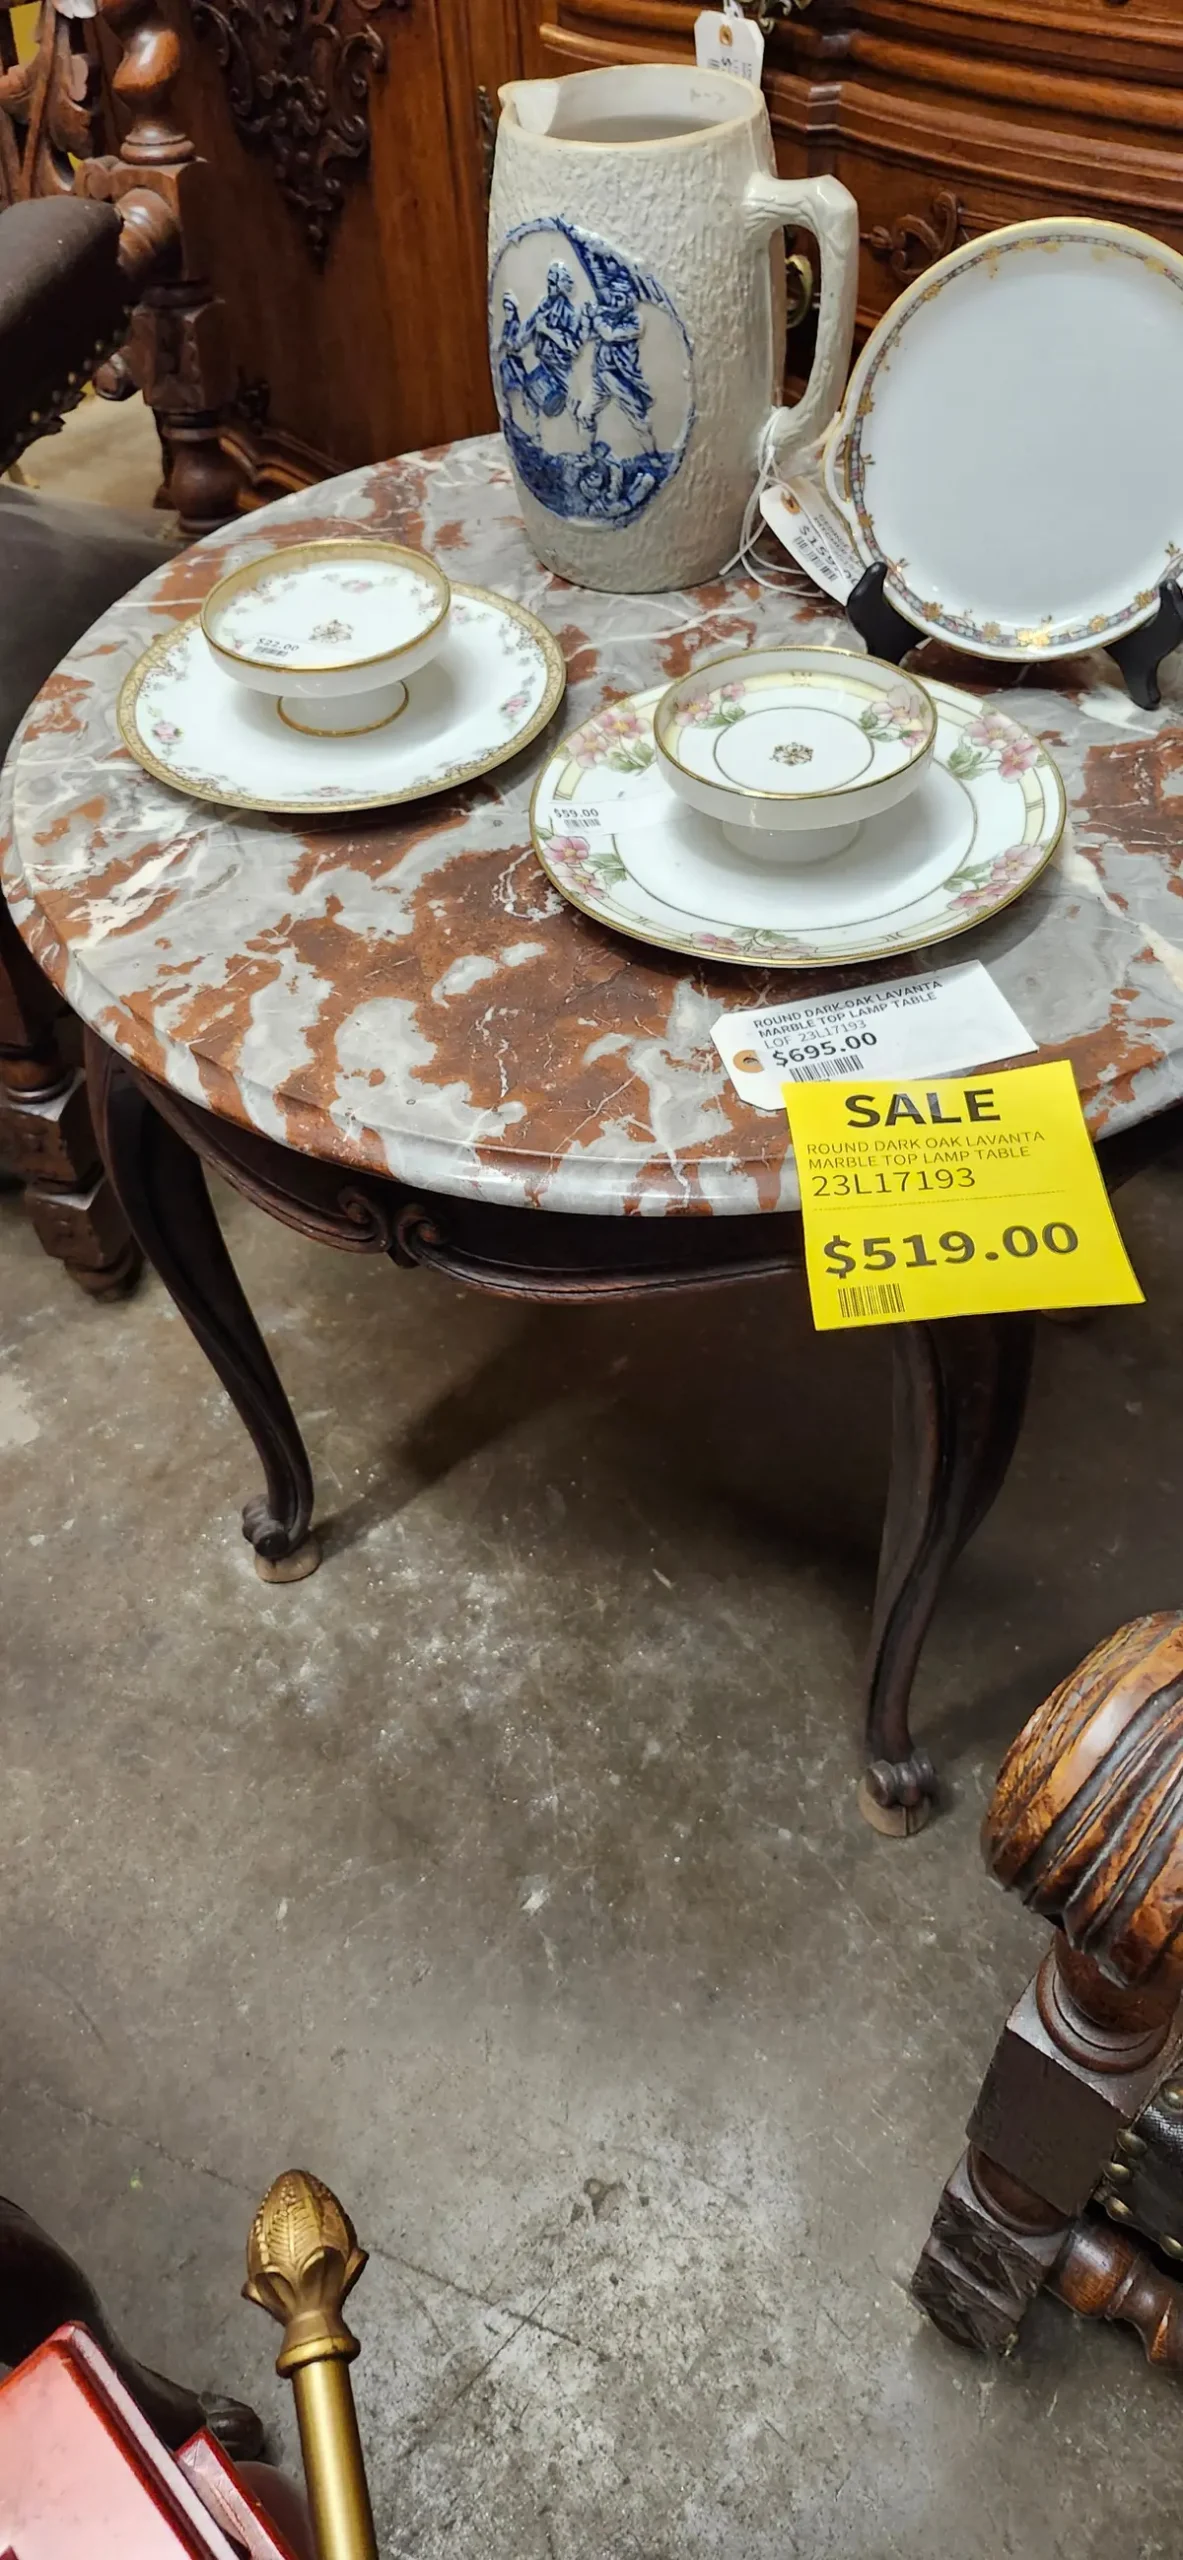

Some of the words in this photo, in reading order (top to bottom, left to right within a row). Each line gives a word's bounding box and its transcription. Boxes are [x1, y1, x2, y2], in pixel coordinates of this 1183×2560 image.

[553, 807, 600, 818] $59.00
[753, 1012, 802, 1029] ROUND
[805, 1002, 842, 1018] DARK
[844, 995, 875, 1009] OAK
[876, 980, 943, 1002] LAVANTA
[758, 1019, 817, 1038] MARBLE
[817, 1013, 846, 1026] TOP
[849, 1002, 888, 1018] LAMP
[891, 991, 937, 1009] TABLE
[764, 1035, 793, 1050] LOF
[798, 1020, 867, 1043] 23L17193
[772, 1031, 878, 1068] $695.00
[844, 1088, 1001, 1129] SALE
[806, 1140, 870, 1156] ROUND
[874, 1138, 921, 1153] DARK
[925, 1135, 960, 1150] OAK
[965, 1131, 1046, 1147] LAVANTA
[808, 1154, 879, 1171] MARBLE
[881, 1152, 919, 1168] TOP
[922, 1149, 971, 1165] LAMP
[976, 1145, 1031, 1161] TABLE
[811, 1167, 977, 1198] 23L17193
[823, 1221, 1079, 1280] $519.00
